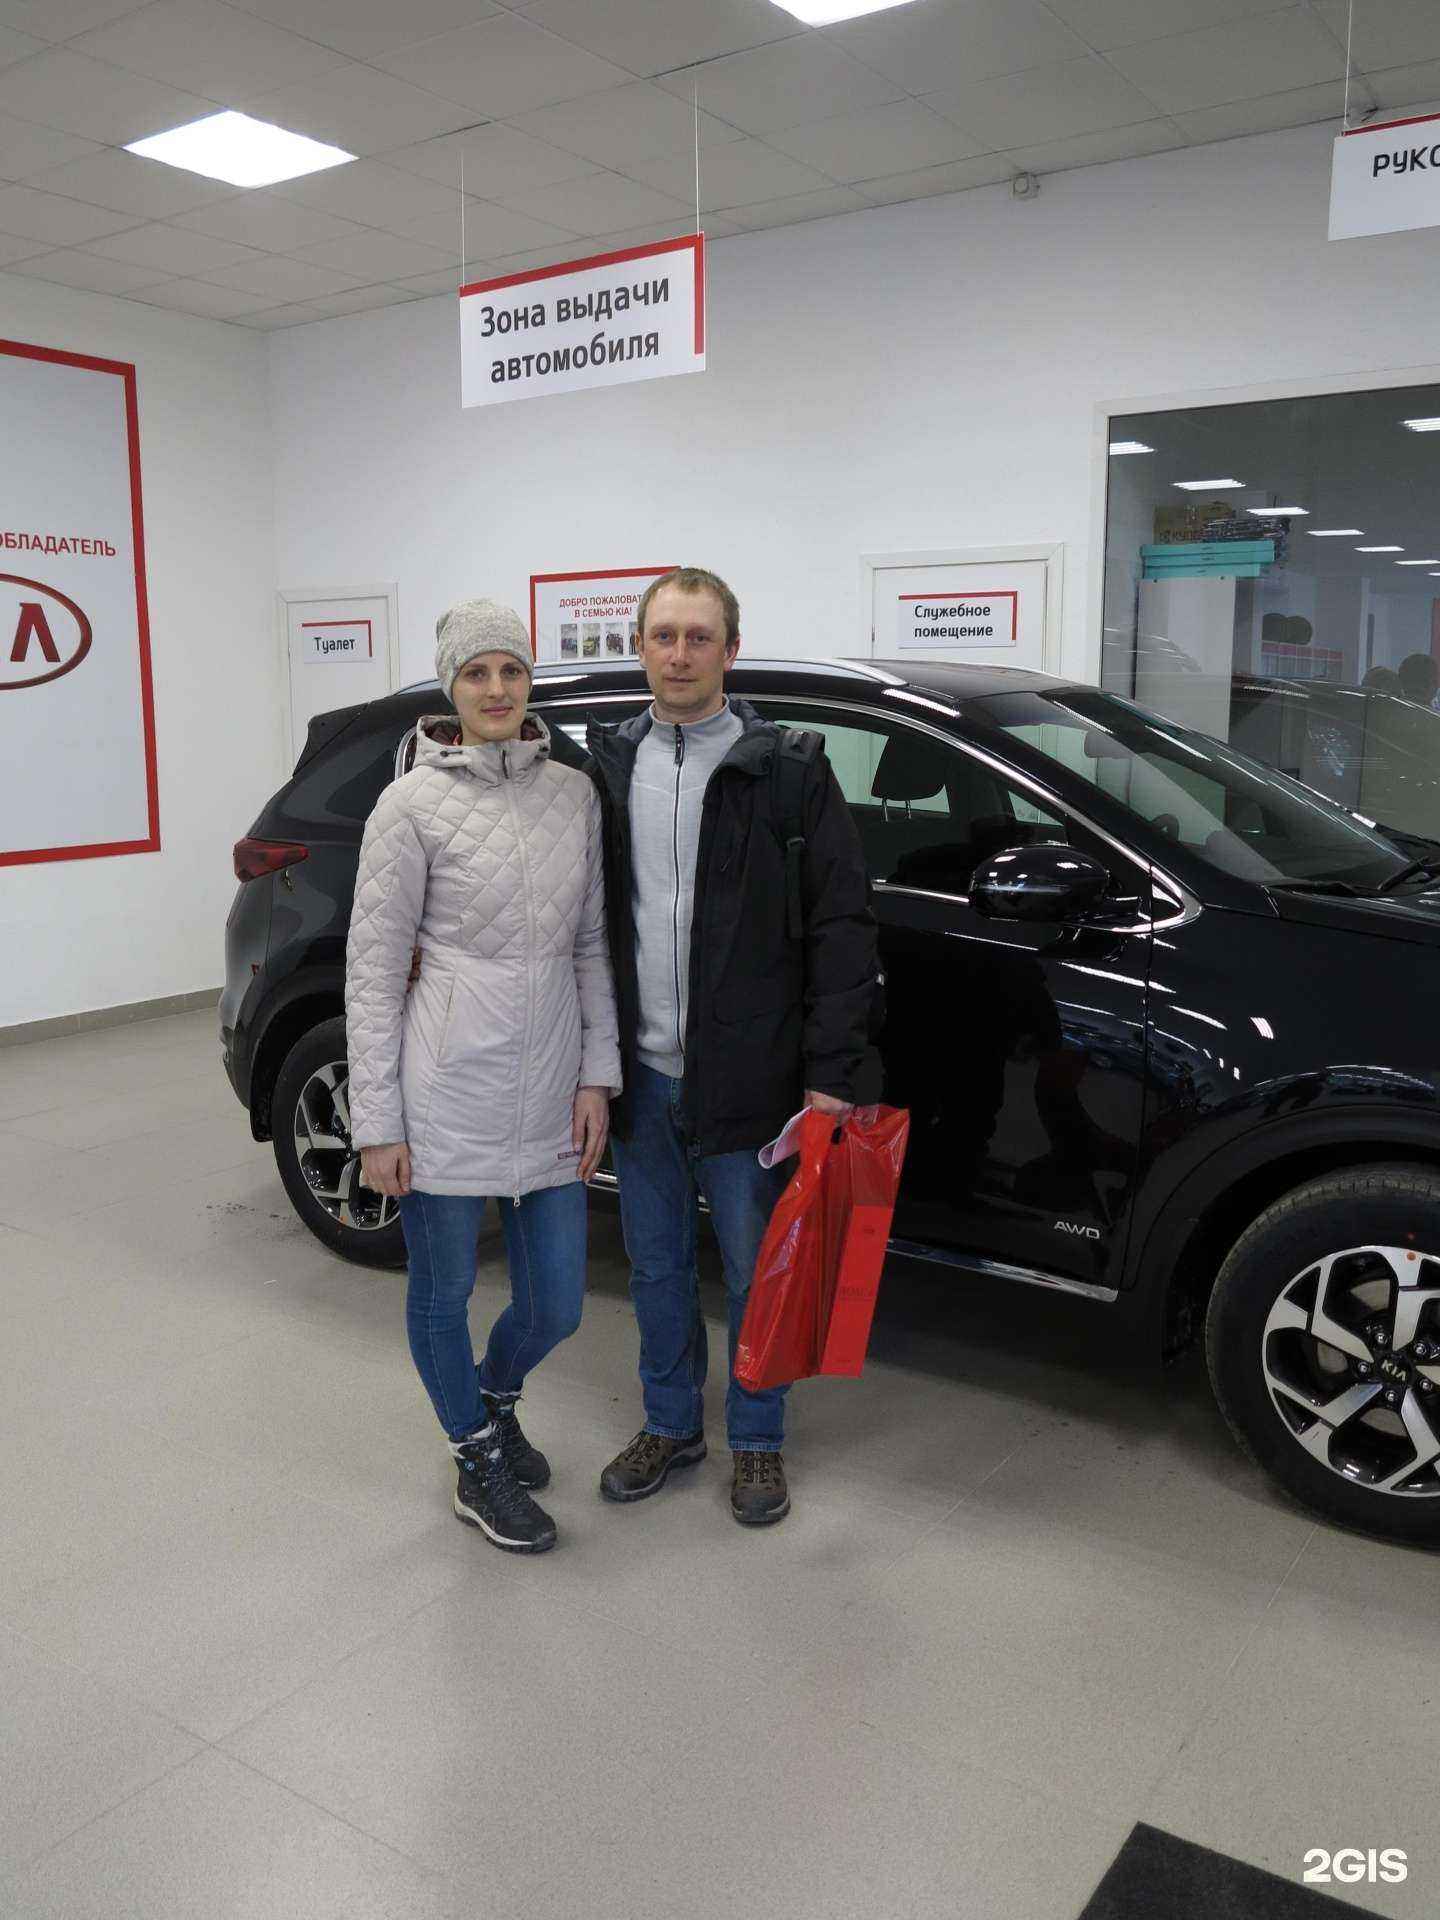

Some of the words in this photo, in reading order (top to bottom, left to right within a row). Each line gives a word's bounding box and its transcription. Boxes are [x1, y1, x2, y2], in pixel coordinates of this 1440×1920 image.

[480, 303, 546, 338] Зона
[556, 277, 670, 324] выдачи
[490, 331, 660, 384] автомобиля
[559, 598, 588, 608] ДОБРО
[914, 603, 991, 621] Служебное
[574, 609, 581, 618] В
[582, 607, 614, 618] СЕМЬЮ
[914, 625, 994, 639] помещение
[314, 637, 356, 654] Туалет
[1054, 1221, 1100, 1239] AWD
[1381, 1359, 1407, 1381] KIA
